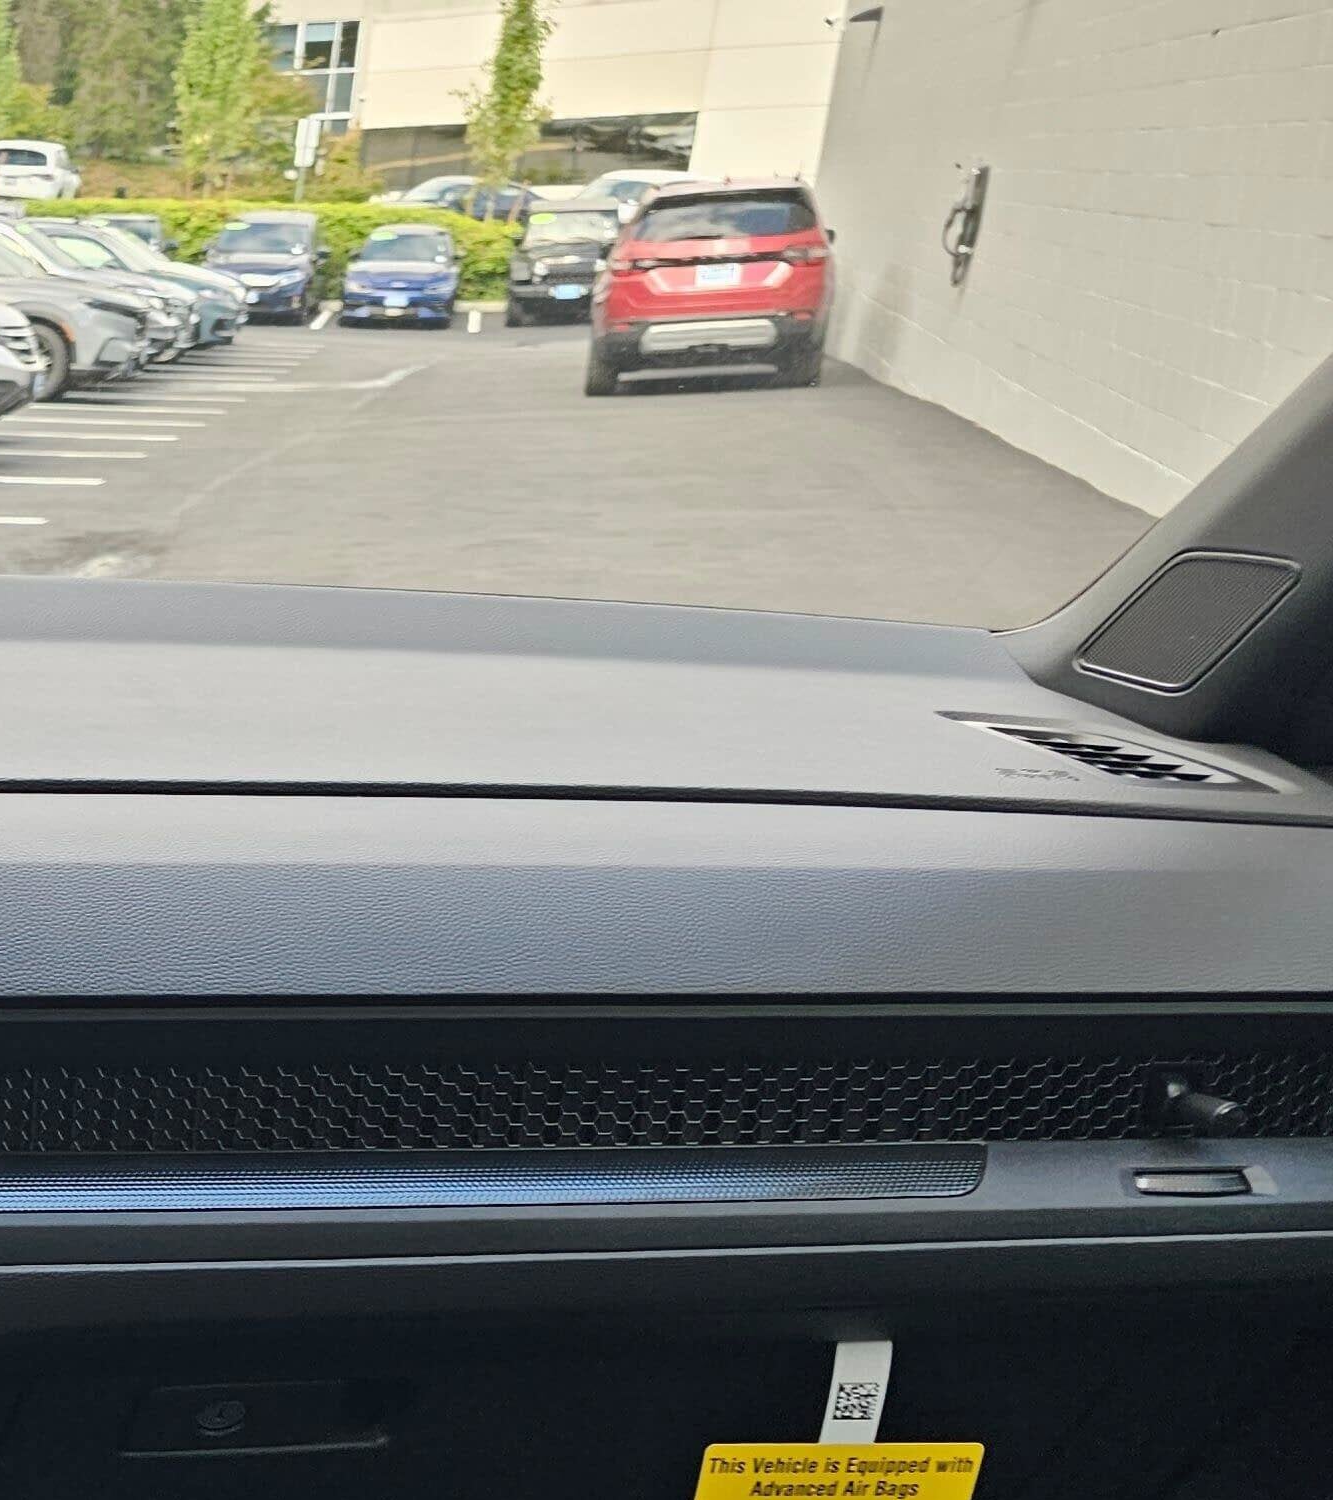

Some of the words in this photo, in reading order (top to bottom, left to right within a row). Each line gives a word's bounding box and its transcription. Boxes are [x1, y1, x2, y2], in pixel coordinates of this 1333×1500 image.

[709, 1457, 745, 1474] This
[752, 1457, 818, 1474] Vehicle
[824, 1458, 839, 1473] is
[845, 1457, 930, 1476] Equipped
[936, 1456, 974, 1473] with
[749, 1481, 837, 1497] Advanced
[843, 1481, 870, 1496] Air
[874, 1481, 919, 1499] Bags
